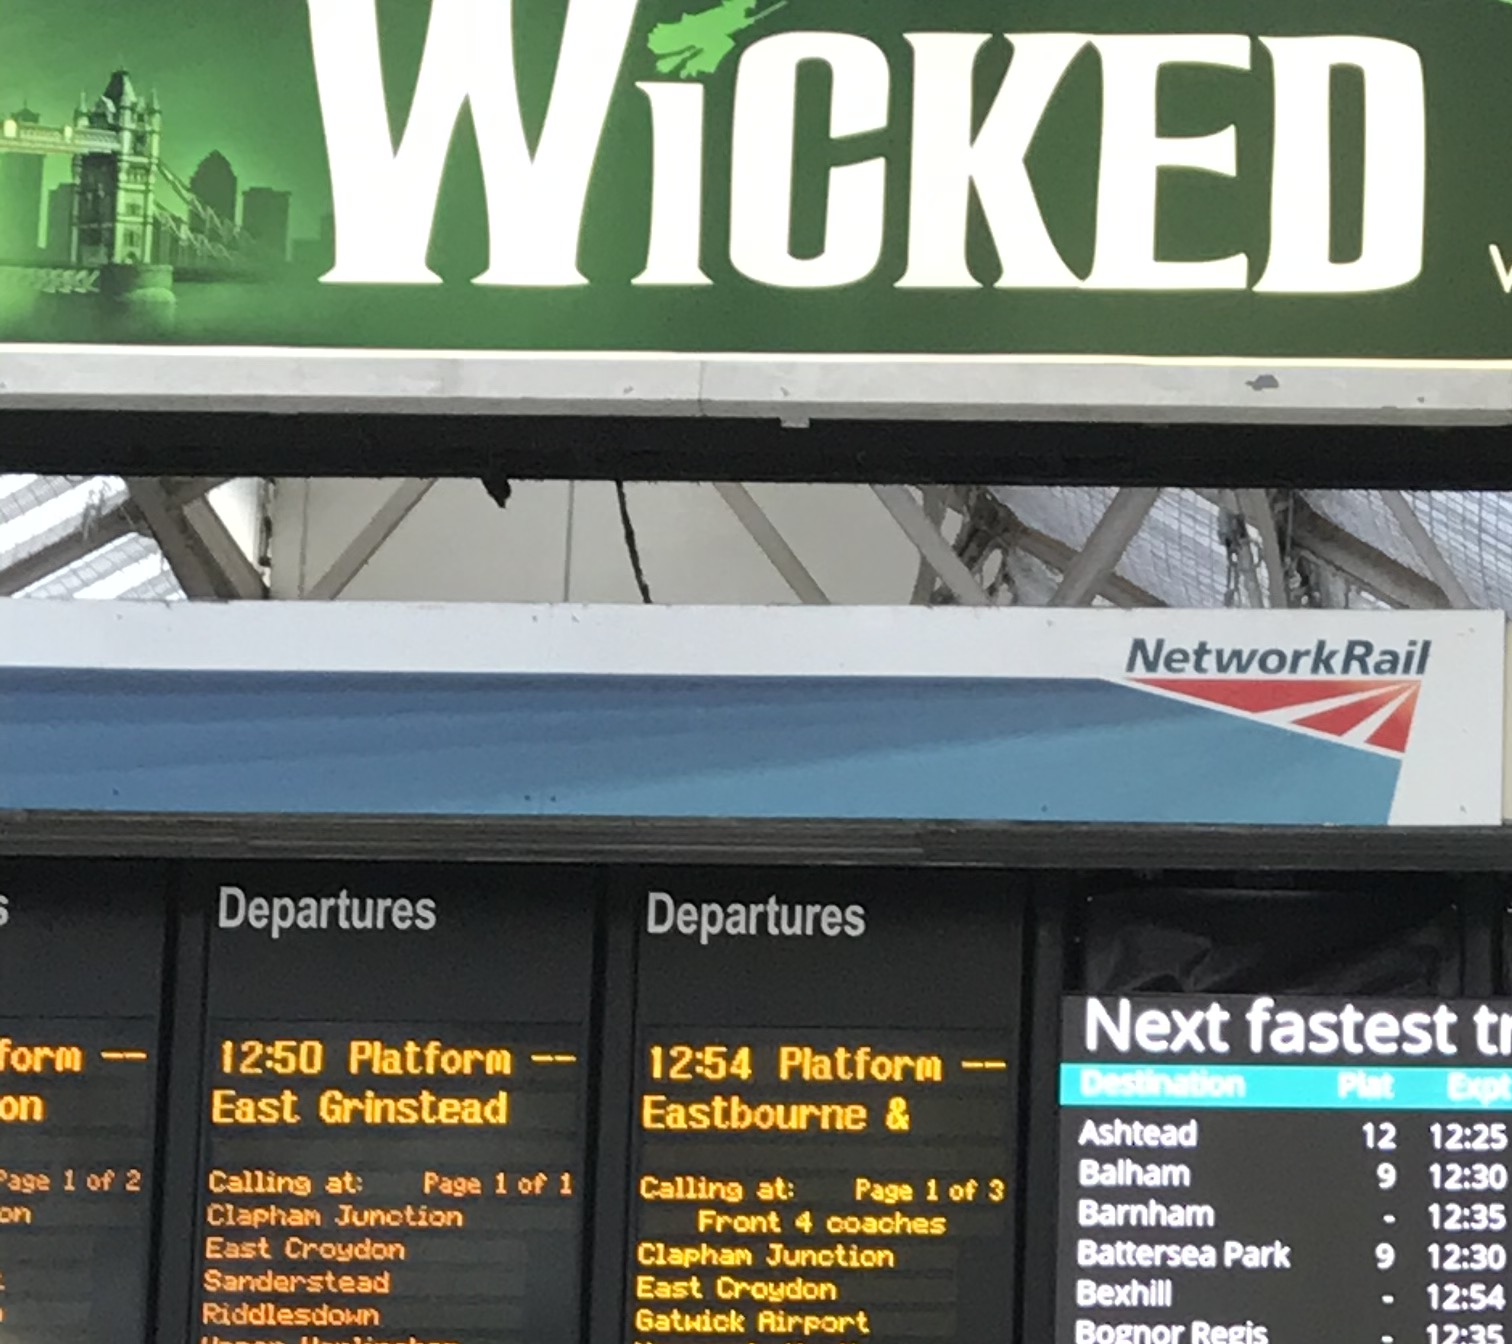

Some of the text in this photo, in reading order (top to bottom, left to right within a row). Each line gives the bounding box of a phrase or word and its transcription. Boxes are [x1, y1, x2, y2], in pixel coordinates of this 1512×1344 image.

[1126, 636, 1431, 678] NetworkRail
[219, 887, 436, 938] Departures
[648, 893, 865, 945] Departures
[1086, 997, 1230, 1053] Next
[1245, 997, 1457, 1055] fastest
[223, 1041, 511, 1074] 12:50 Platform
[651, 1046, 942, 1081] 12:54 Platform
[1079, 1068, 1512, 1105] Destination Plat Expt
[212, 1090, 507, 1124] East Grinstead
[643, 1095, 909, 1130] Eastbourne &
[1078, 1118, 1508, 1151] Ashtead 12 12:25
[208, 1204, 463, 1228] Clapham Junction
[1077, 1239, 1506, 1271] Battersea Park 9 12:30
[203, 1303, 379, 1325] Riddlesdown
